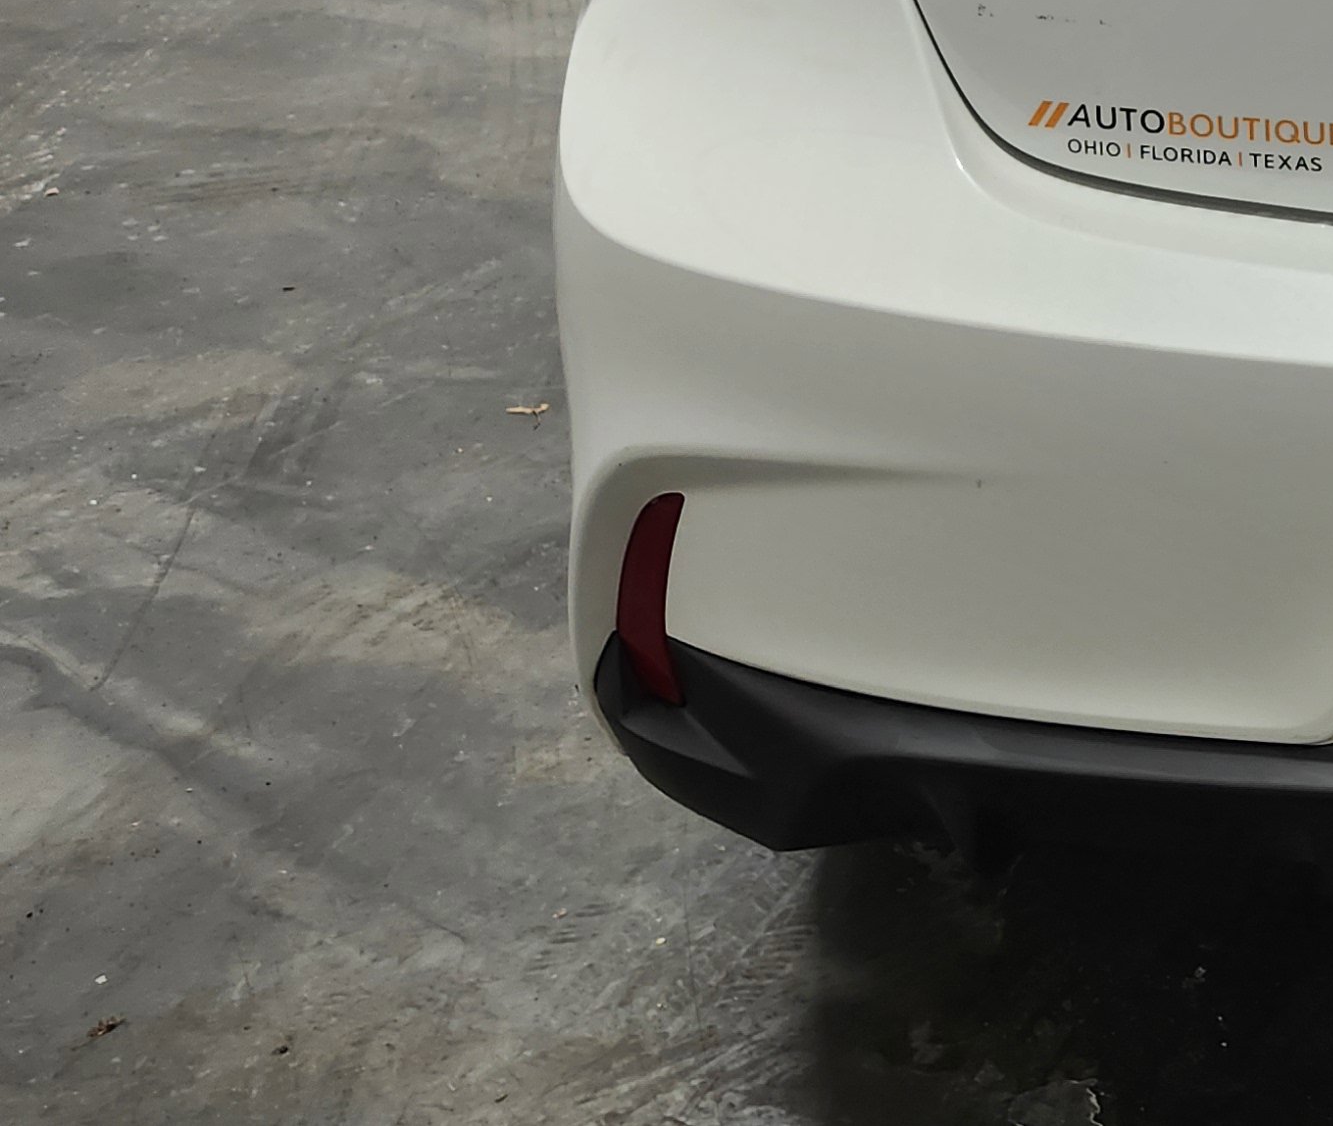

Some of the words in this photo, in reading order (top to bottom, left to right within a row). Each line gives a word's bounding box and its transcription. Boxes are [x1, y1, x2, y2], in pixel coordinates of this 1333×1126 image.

[1067, 138, 1121, 158] OHIO
[1139, 144, 1232, 167] FLORIDA
[1249, 152, 1322, 172] TEXAS
